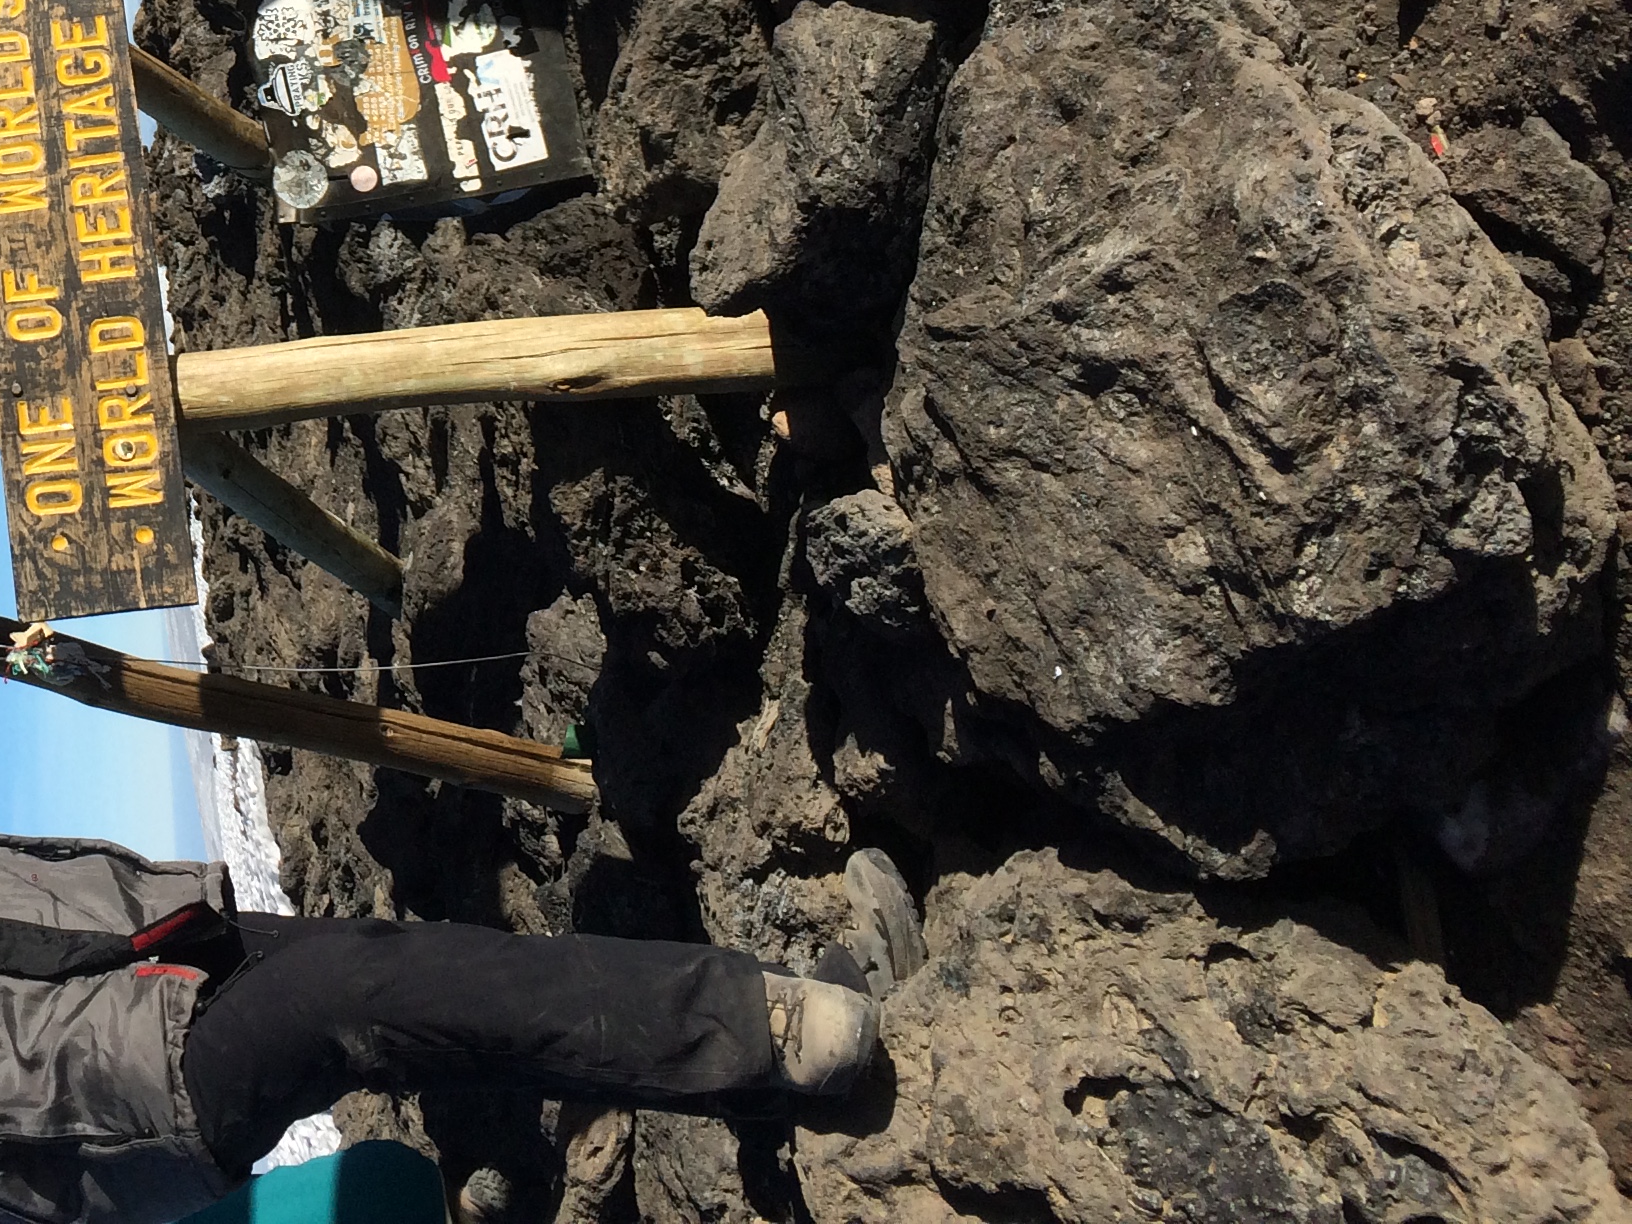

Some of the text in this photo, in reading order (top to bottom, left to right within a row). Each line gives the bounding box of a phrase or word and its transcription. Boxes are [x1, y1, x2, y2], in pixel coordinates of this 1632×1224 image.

[49, 14, 136, 281] HERITAGE
[2, 270, 63, 341] OF
[16, 396, 85, 517] ONE
[88, 315, 164, 510] WORLD
